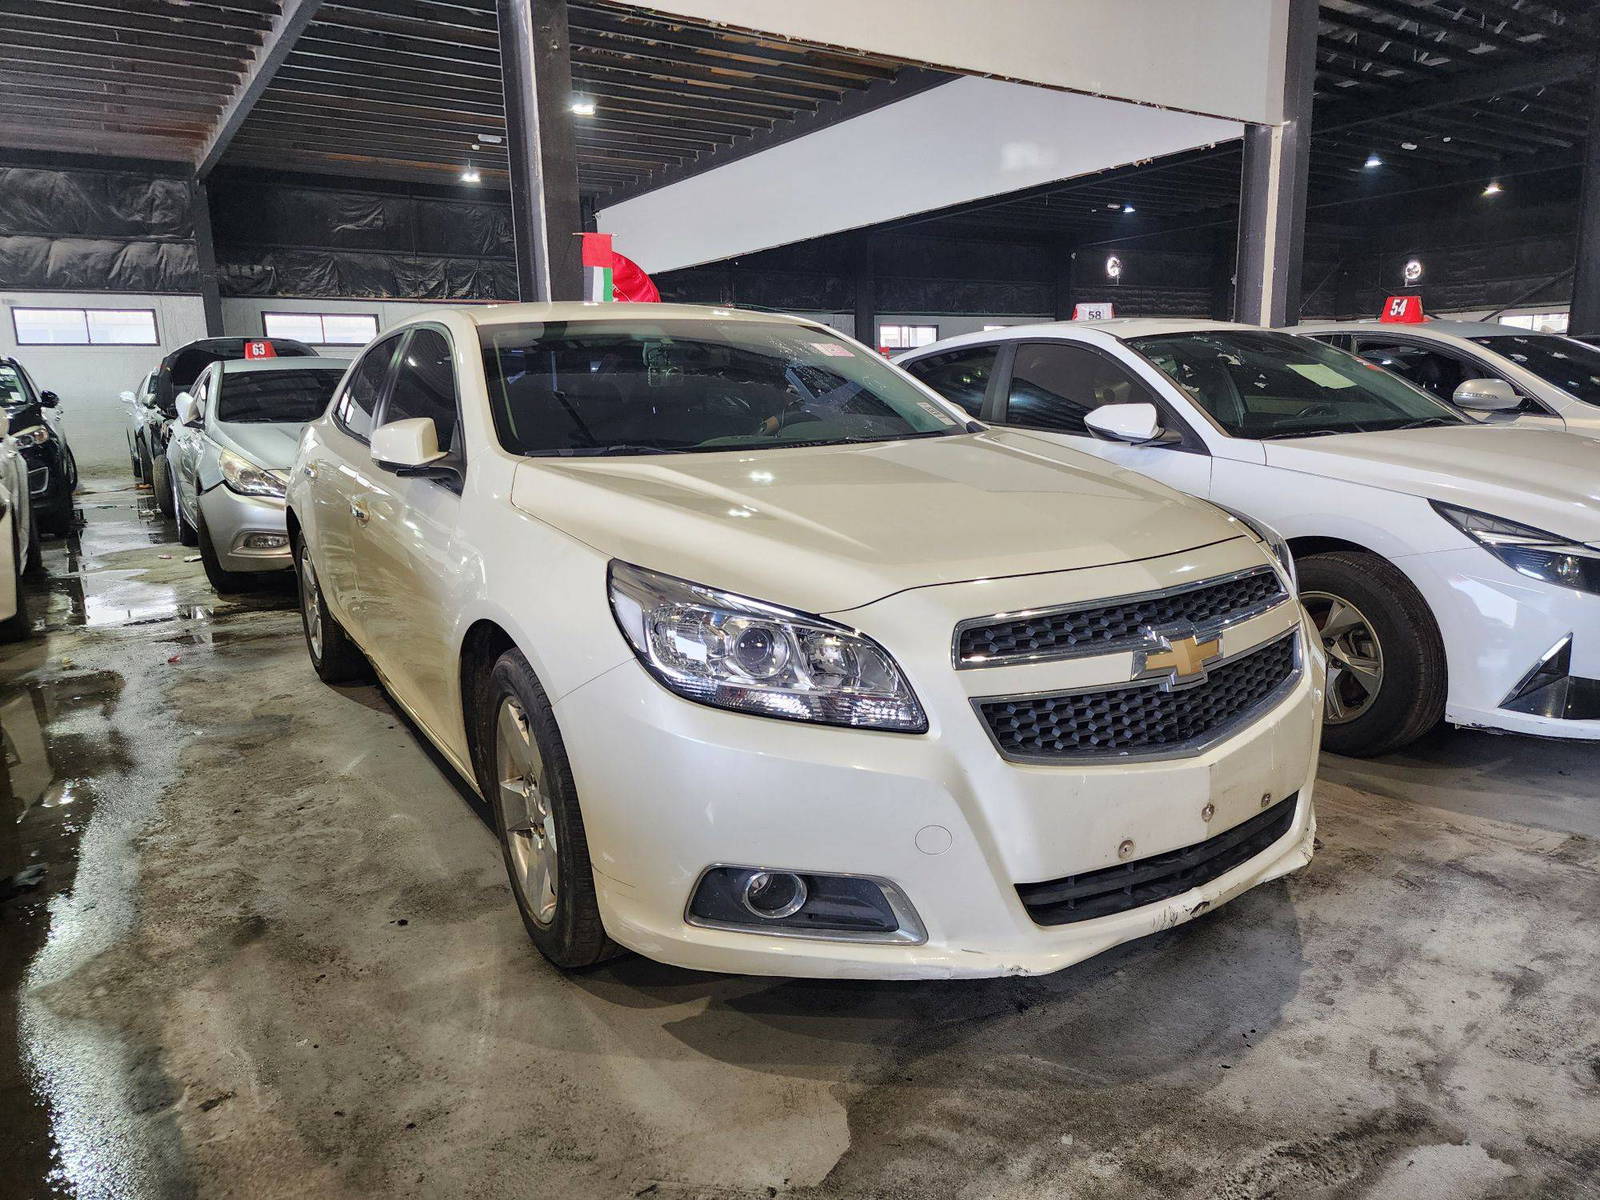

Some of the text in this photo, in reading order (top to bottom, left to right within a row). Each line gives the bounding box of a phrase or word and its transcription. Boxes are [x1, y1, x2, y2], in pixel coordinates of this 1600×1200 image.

[1390, 299, 1408, 316] 54
[1088, 311, 1102, 320] 58
[252, 343, 265, 355] 63
